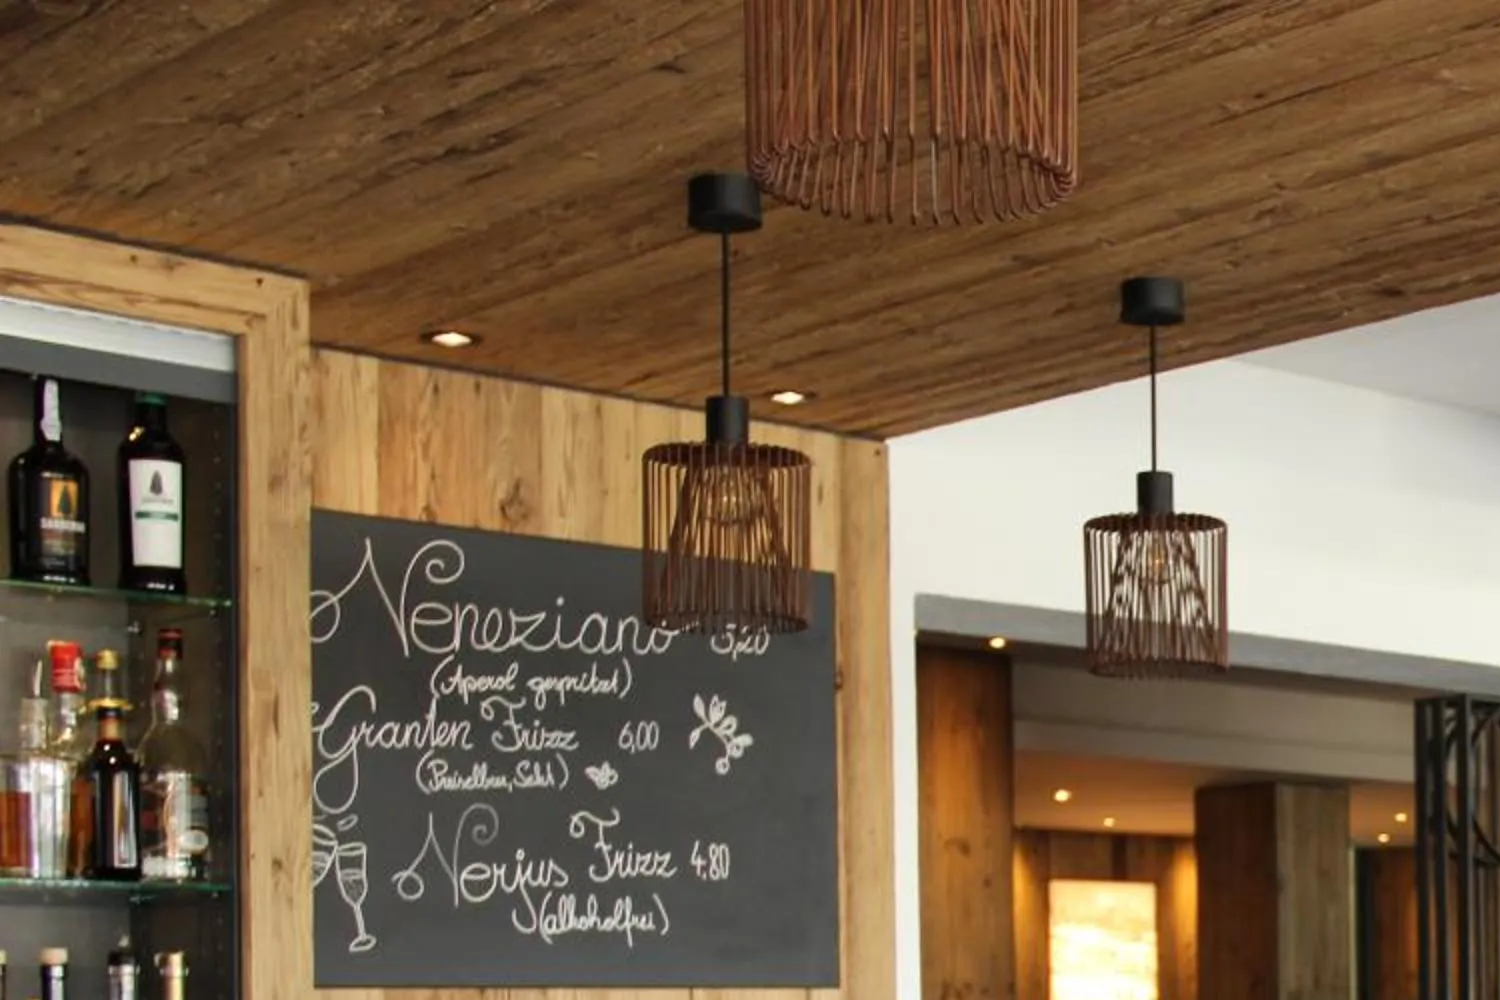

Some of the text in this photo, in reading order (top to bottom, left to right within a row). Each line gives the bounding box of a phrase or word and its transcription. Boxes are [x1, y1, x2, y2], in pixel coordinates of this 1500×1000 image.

[480, 695, 579, 753] Frizz
[618, 720, 660, 754] 6,00
[569, 807, 678, 883] Frizz
